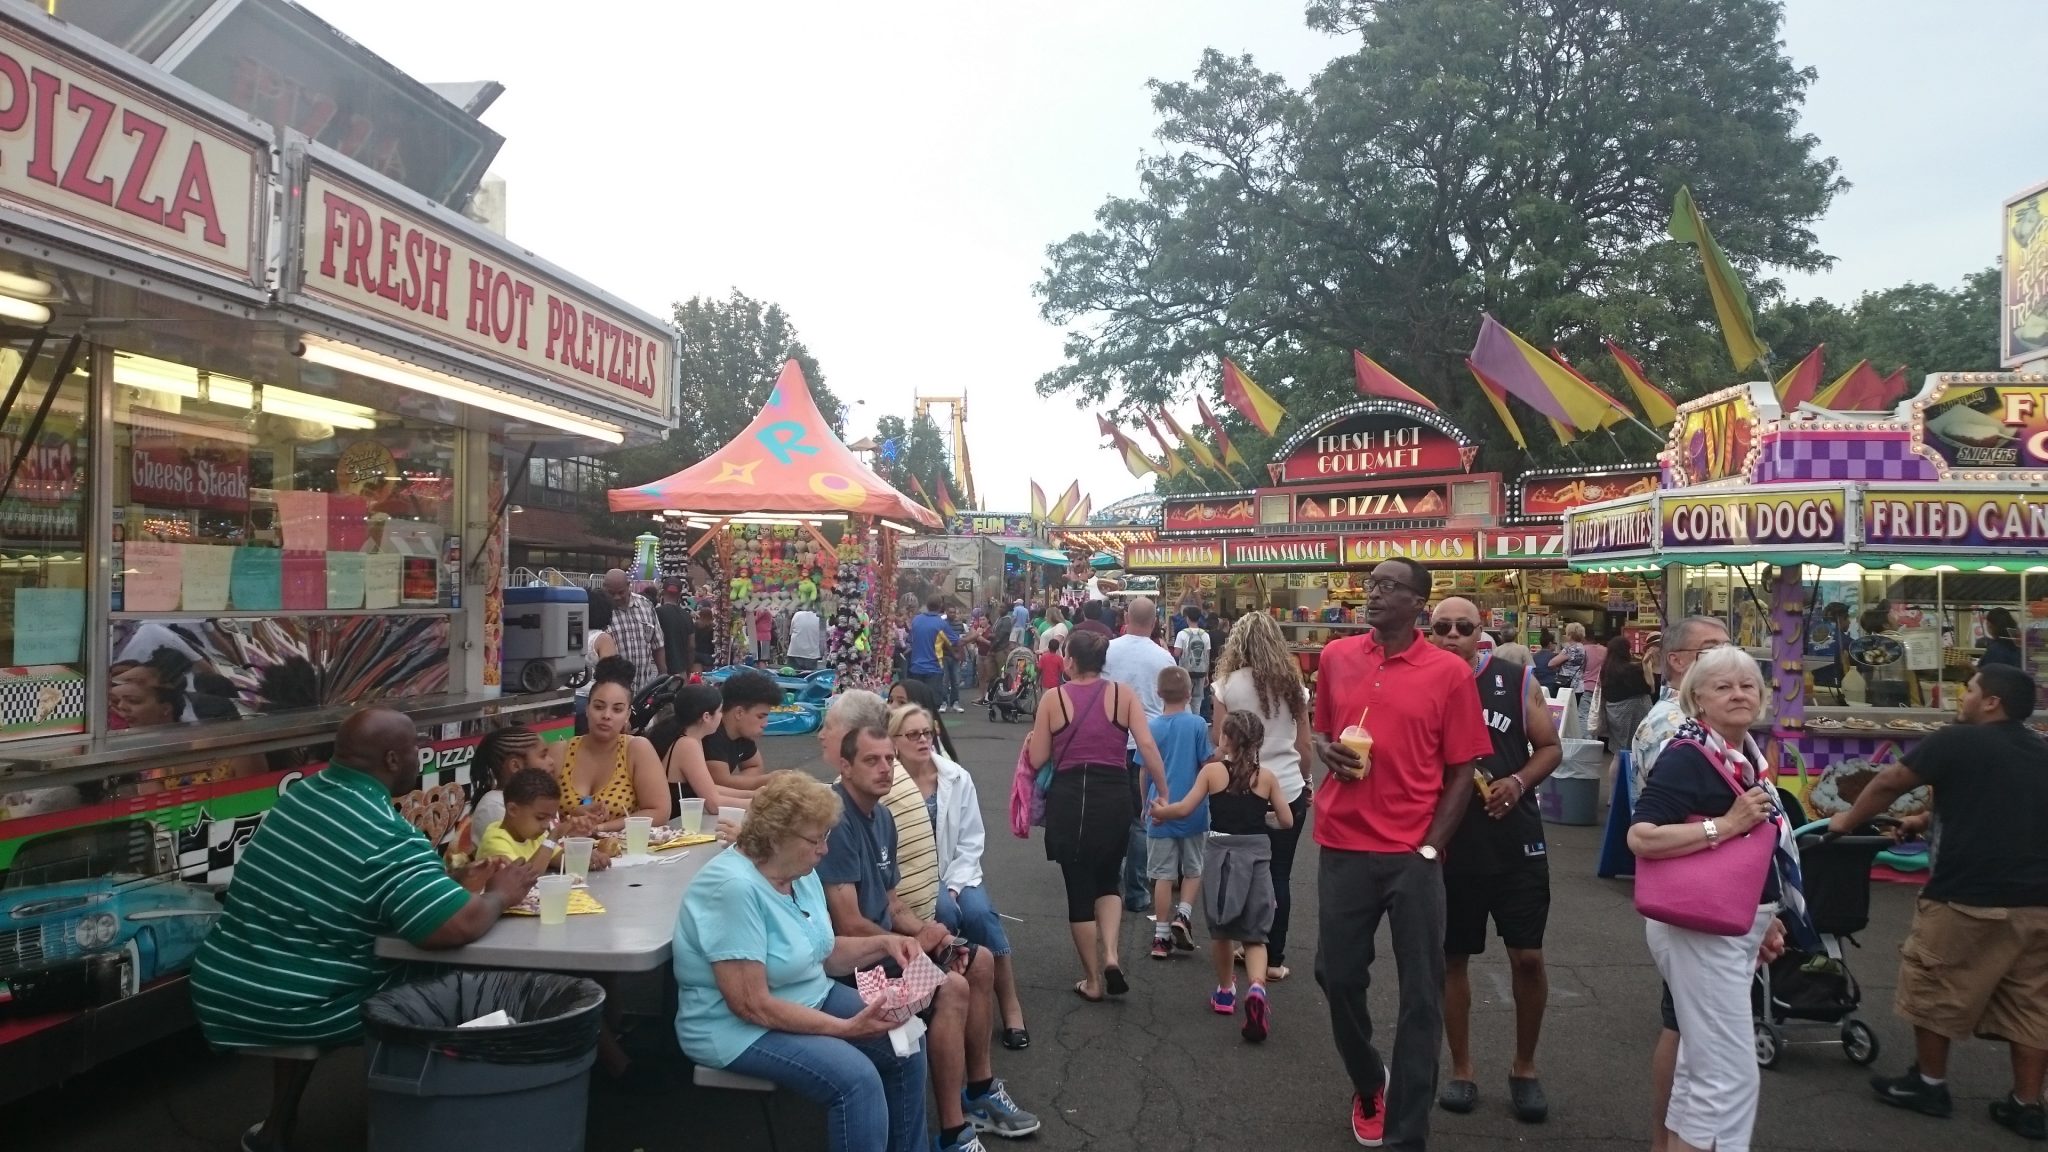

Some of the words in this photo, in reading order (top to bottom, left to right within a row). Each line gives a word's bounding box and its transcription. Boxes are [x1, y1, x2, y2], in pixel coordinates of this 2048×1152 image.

[0, 51, 226, 248] PIZZA
[320, 190, 451, 321] FRESH
[466, 258, 534, 350] HOT
[545, 294, 657, 399] PRETZELS
[1318, 431, 1375, 454] FRESH
[1383, 426, 1422, 448] HOT
[1318, 448, 1422, 474] GOURMET
[1956, 447, 2018, 462] SNICKERS
[132, 449, 193, 493] Cheese
[197, 459, 248, 499] Steak
[1328, 493, 1409, 517] PIZZA
[973, 517, 1005, 534] FUN
[1574, 519, 1600, 549] FRIED
[1602, 509, 1652, 548] TWINKIES
[1672, 502, 1749, 541] CORN
[1755, 500, 1835, 538] DOGS
[1871, 501, 1969, 538] FRIED
[1135, 547, 1173, 563] FUNNEL
[1177, 546, 1214, 562] CAKES
[1236, 545, 1278, 562] ITALIAN
[1281, 543, 1329, 561] SAUSAGE
[1355, 540, 1404, 559] CORN
[1410, 537, 1464, 558] DOGS
[956, 581, 972, 591] 22
[417, 745, 475, 773] PIZZA
